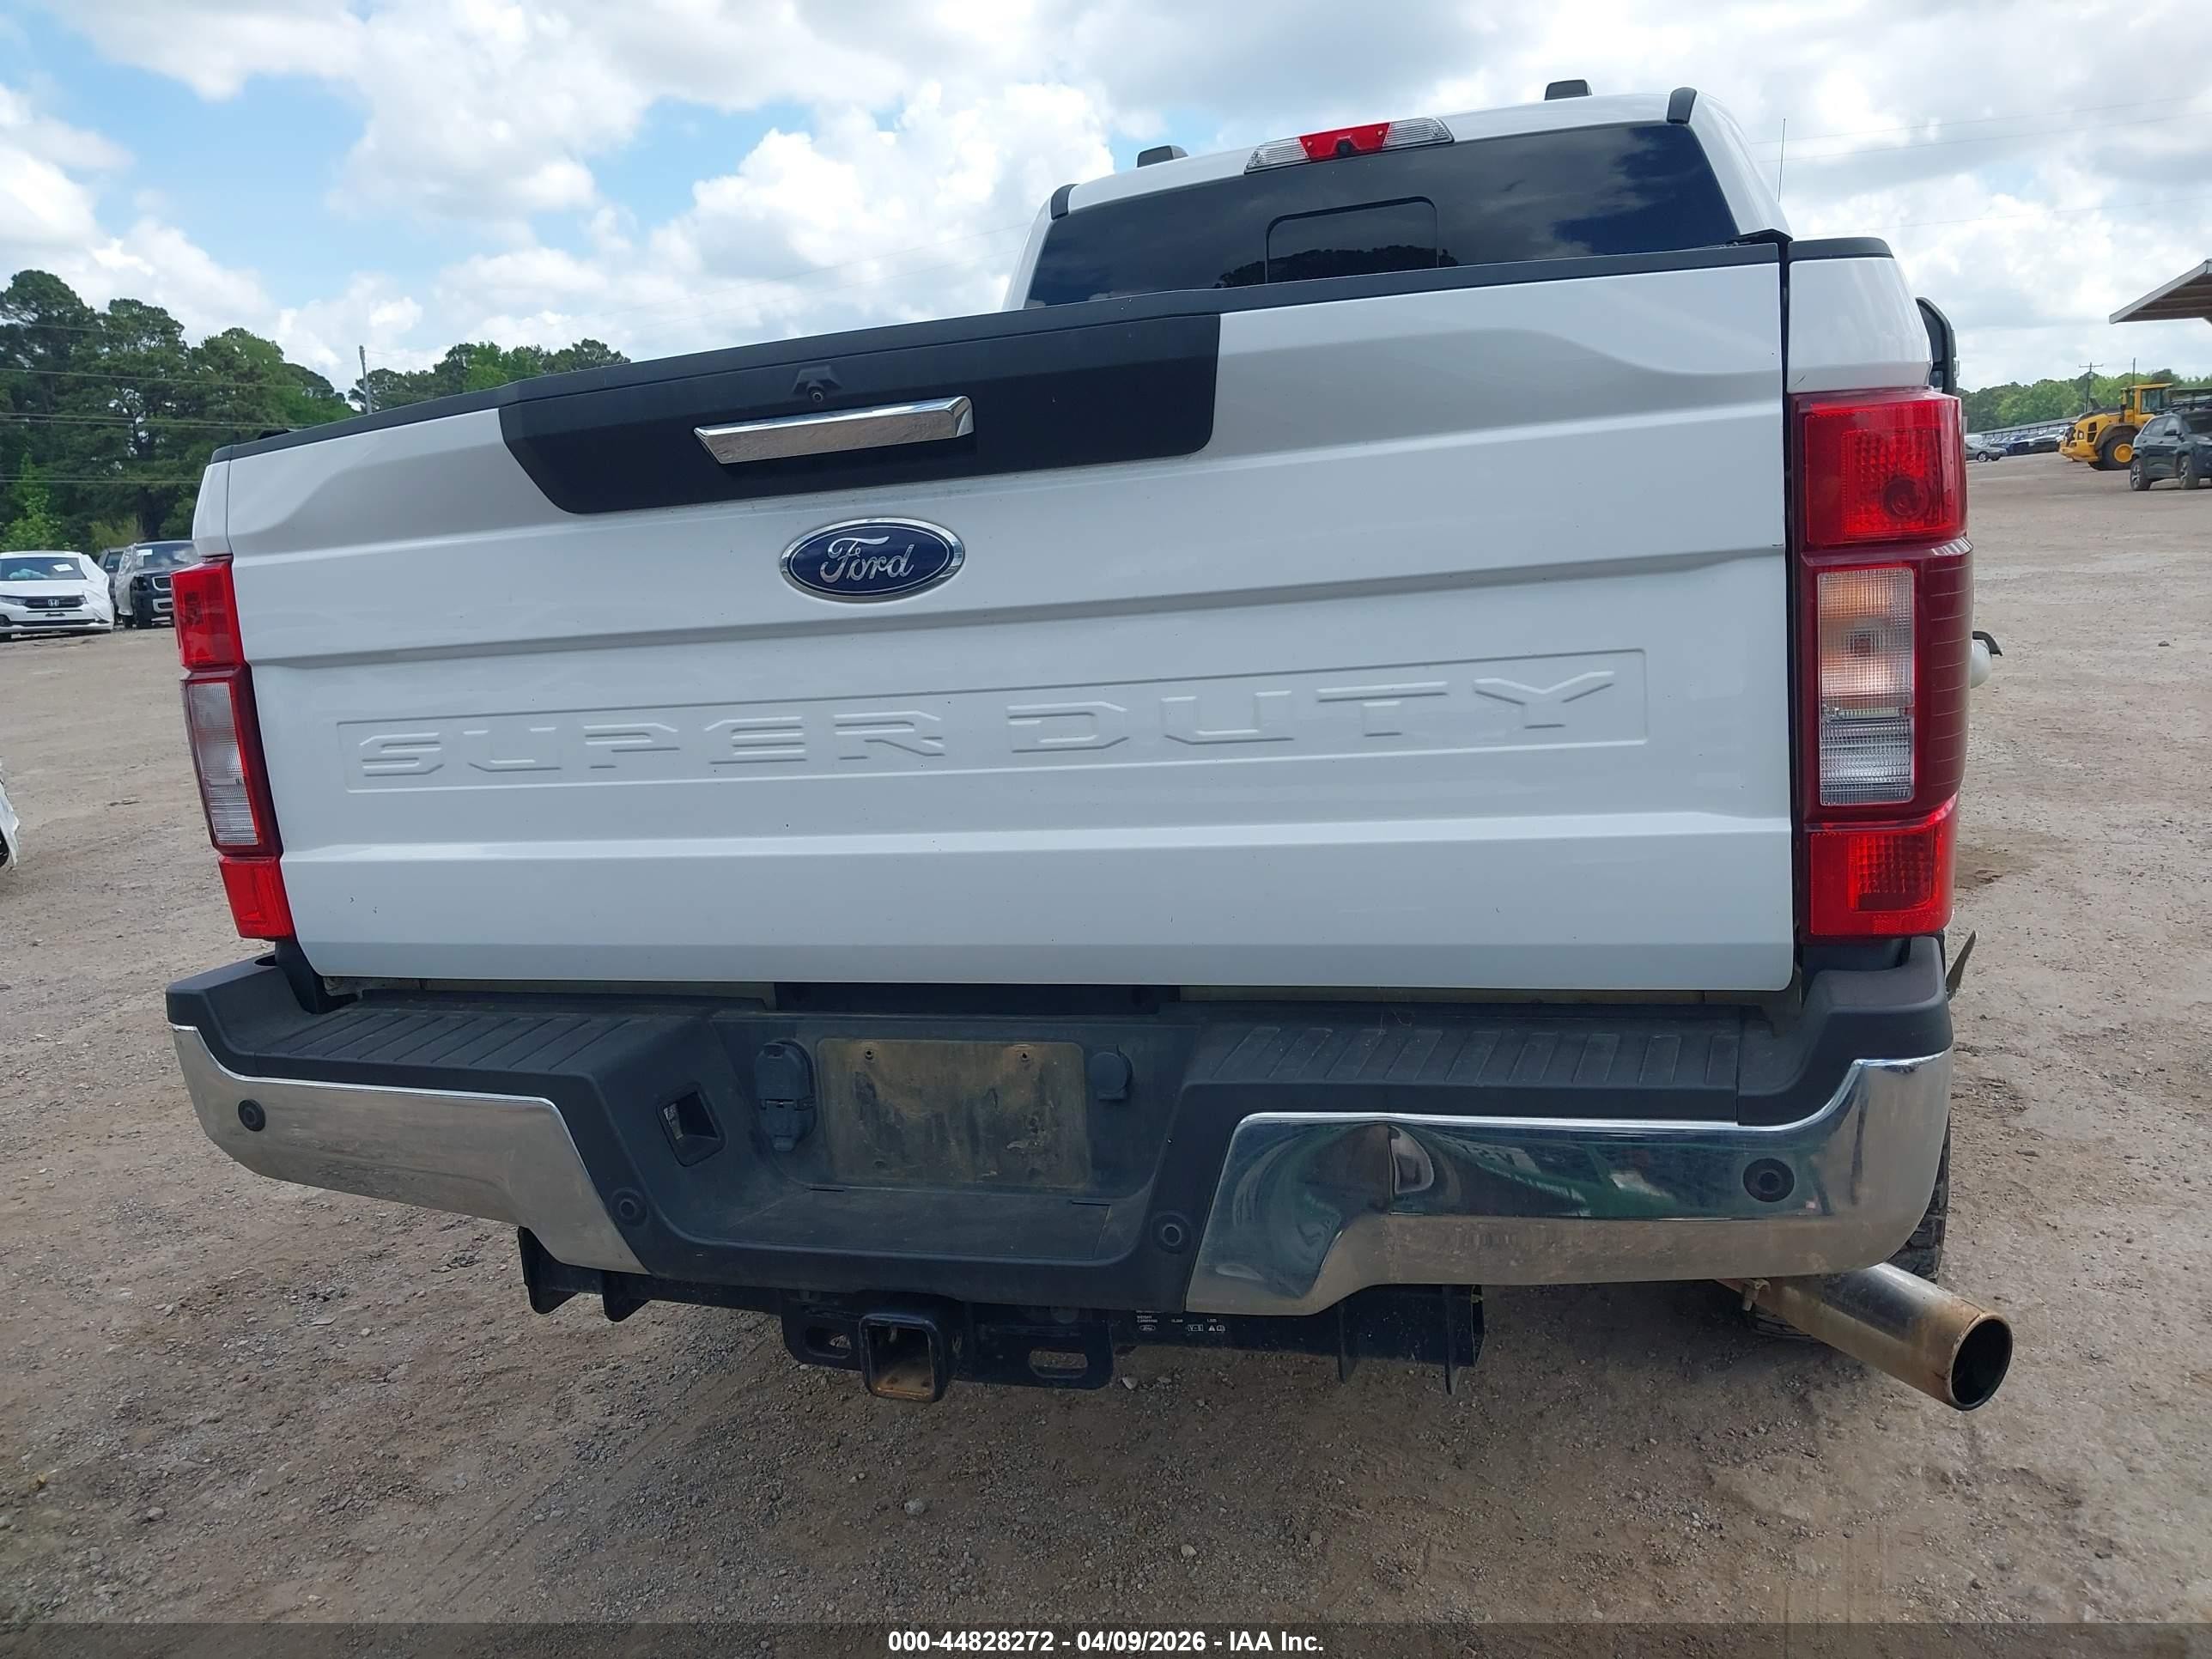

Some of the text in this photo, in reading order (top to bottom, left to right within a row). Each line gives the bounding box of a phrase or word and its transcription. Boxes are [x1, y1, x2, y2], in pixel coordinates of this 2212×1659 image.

[819, 536, 915, 584] Ford
[358, 670, 1615, 778] SUPER DUTY
